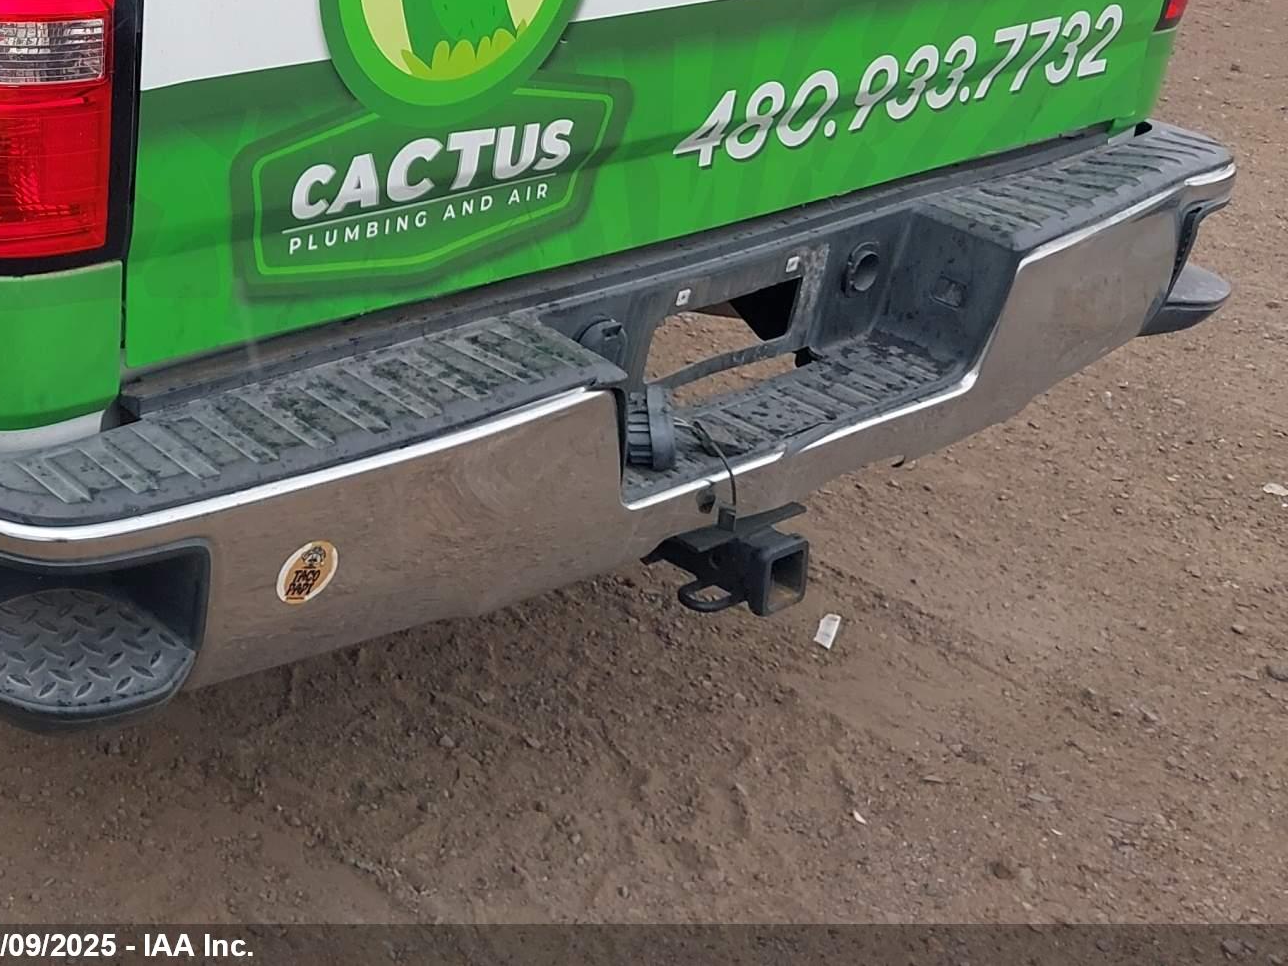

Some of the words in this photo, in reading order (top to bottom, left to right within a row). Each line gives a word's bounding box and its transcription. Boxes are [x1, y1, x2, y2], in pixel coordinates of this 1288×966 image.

[672, 4, 1124, 168] 480.933.7732
[291, 118, 575, 221] CACTUS
[288, 210, 430, 255] PLUMBING
[442, 194, 494, 221] AND
[507, 183, 549, 205] AIR
[284, 581, 314, 596] PAPI
[293, 569, 321, 583] TACO
